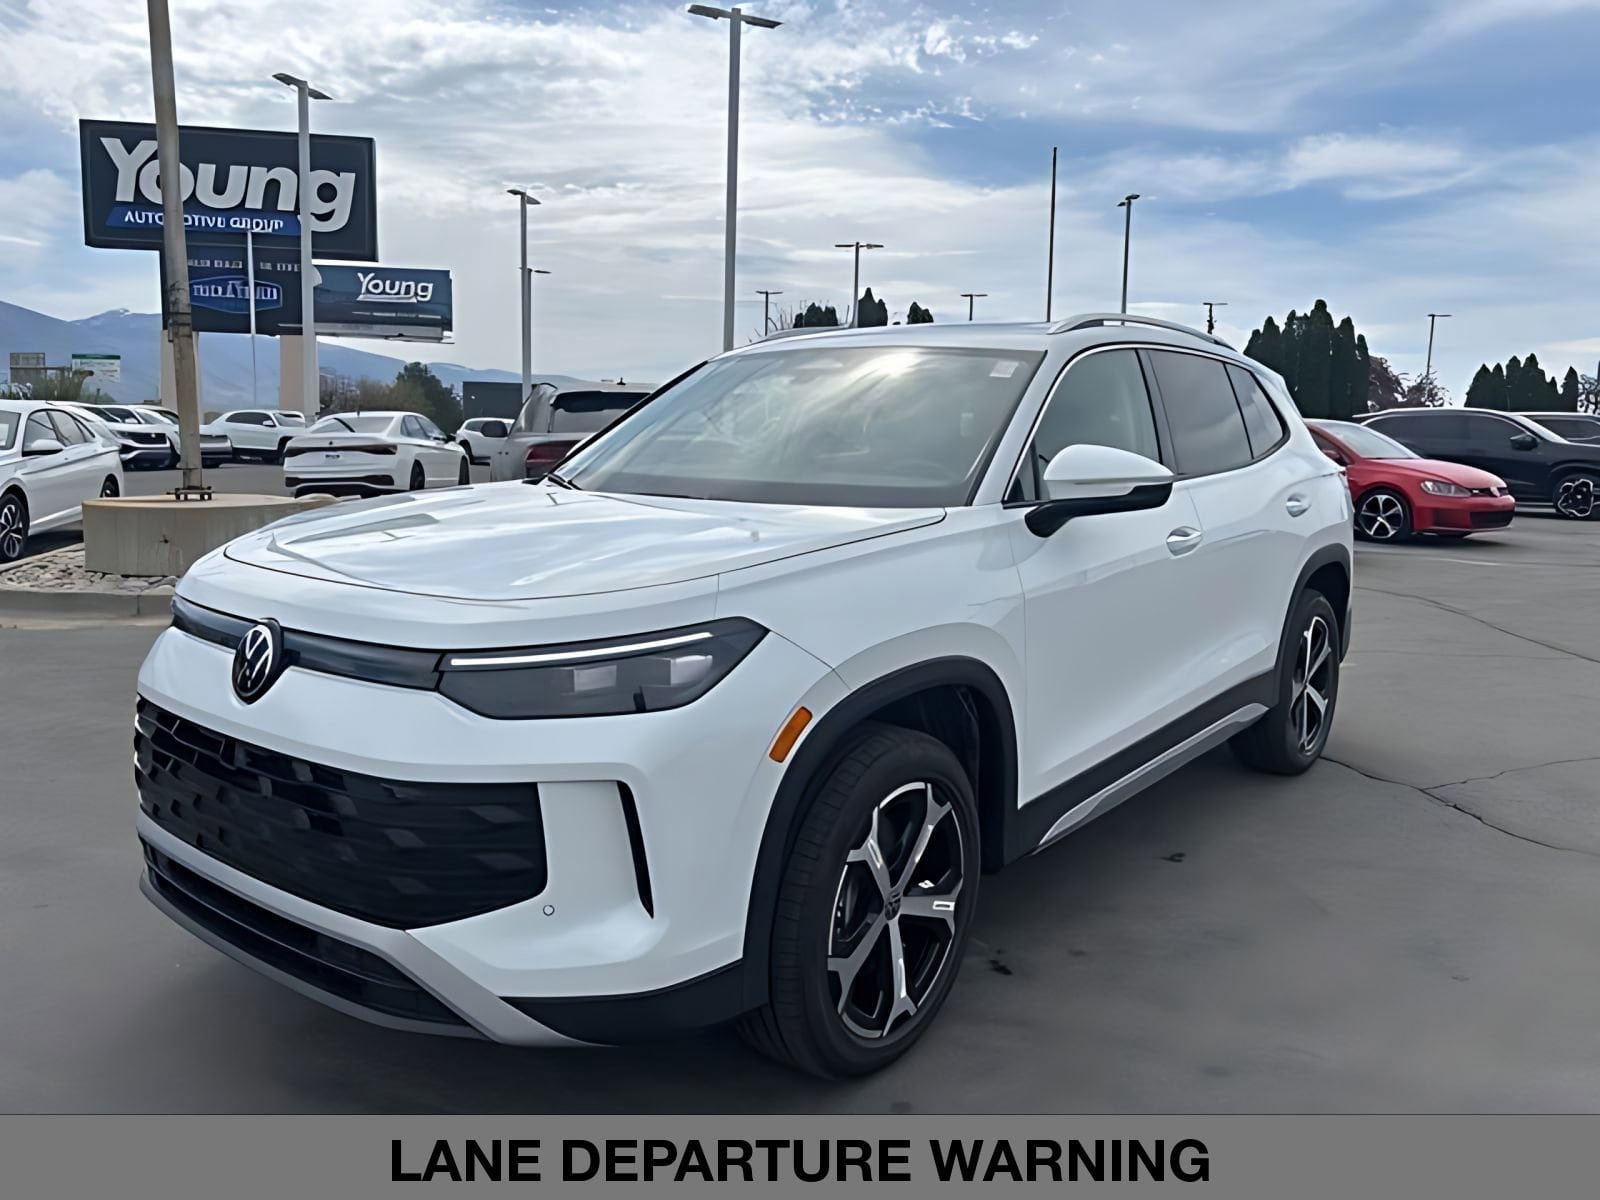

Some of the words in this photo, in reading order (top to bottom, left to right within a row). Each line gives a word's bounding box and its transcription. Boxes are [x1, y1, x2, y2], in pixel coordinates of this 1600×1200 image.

[100, 137, 356, 233] Young
[125, 210, 226, 228] AUTOOTIV
[357, 272, 434, 302] Young
